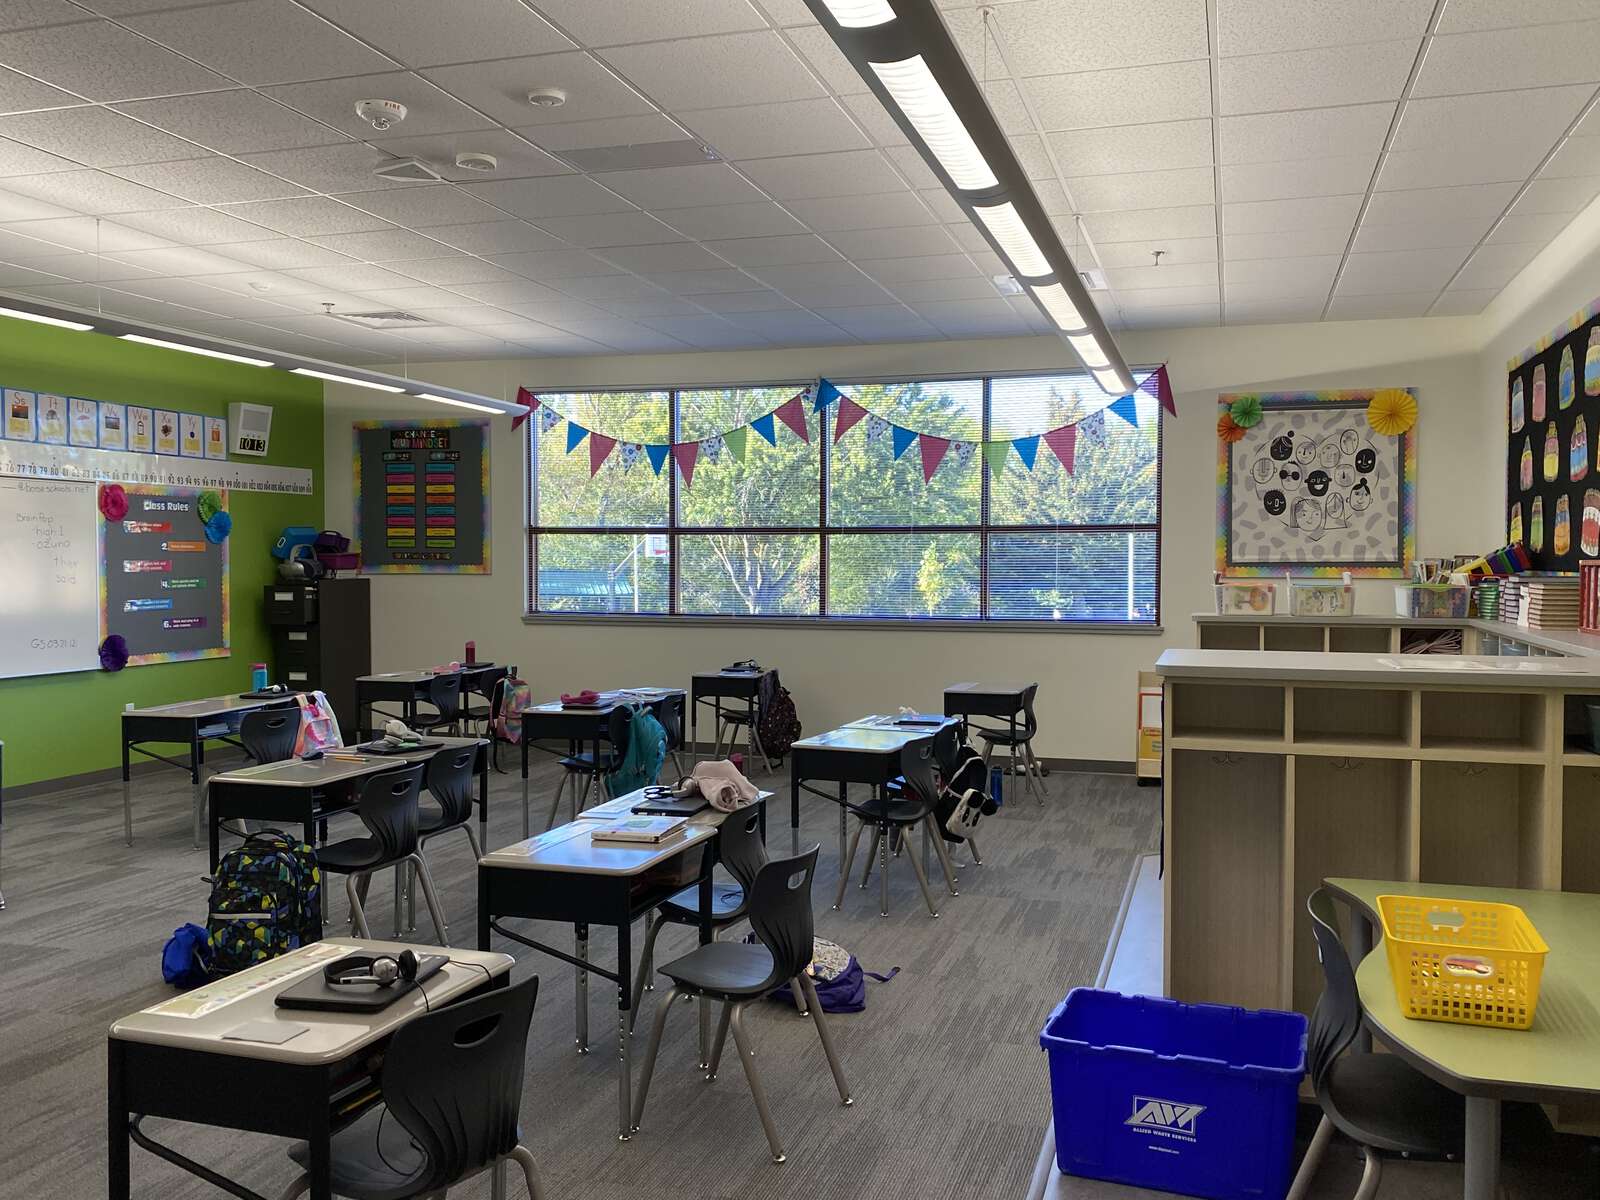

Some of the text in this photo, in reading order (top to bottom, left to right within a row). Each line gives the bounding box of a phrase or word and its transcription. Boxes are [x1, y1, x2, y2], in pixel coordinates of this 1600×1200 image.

[384, 101, 400, 110] FIRE
[411, 438, 449, 449] MINDSET
[143, 500, 189, 512] Class Rules
[1152, 1130, 1171, 1138] WASTE
[1171, 1134, 1197, 1142] SERVICES
